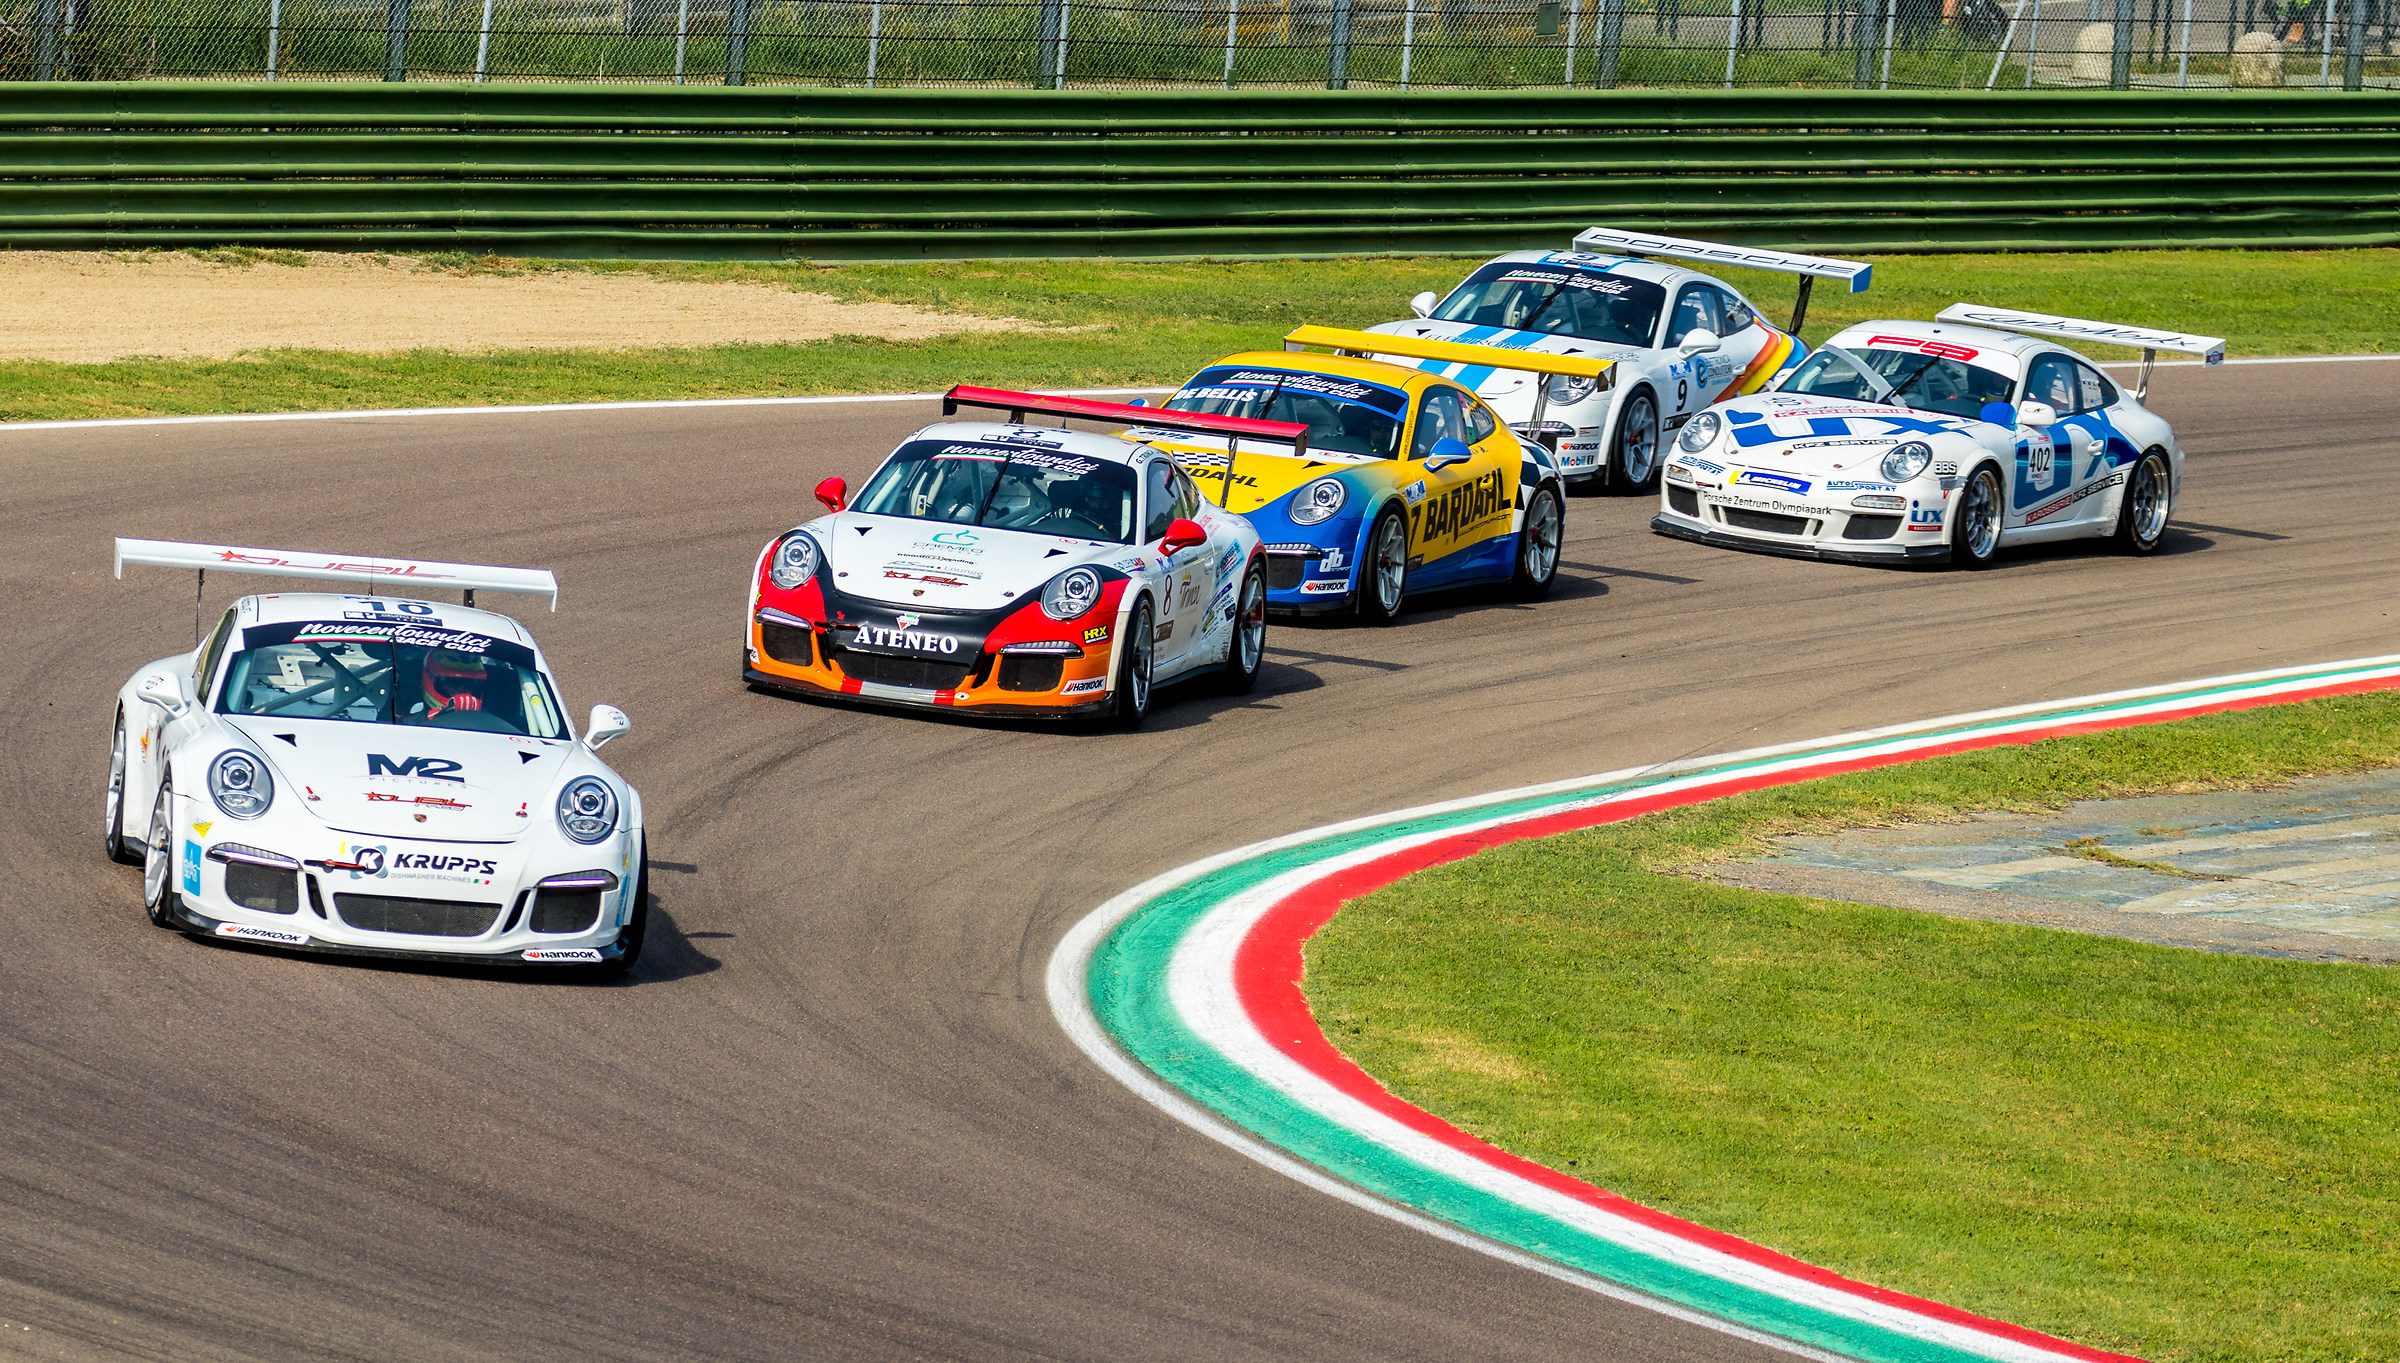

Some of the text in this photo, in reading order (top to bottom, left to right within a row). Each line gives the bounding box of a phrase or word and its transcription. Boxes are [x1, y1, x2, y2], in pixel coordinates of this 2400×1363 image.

[1590, 234, 1857, 274] PORSCHE
[1592, 285, 1622, 296] CUP
[1172, 388, 1259, 402] DE BELLIS
[1230, 371, 1373, 397] Novecntoundici
[1289, 382, 1361, 400] RACE CUP
[1676, 379, 1688, 412] 9
[1794, 438, 1897, 450] KFZ SERVICE
[1009, 457, 1088, 476] RACE CUP
[1561, 455, 1587, 467] Mobil
[1934, 460, 1958, 476] BBS
[2029, 446, 2051, 473] 402
[1750, 475, 1802, 490] MICHELIN
[2073, 474, 2123, 502] KFZ SERVICE
[1408, 467, 1512, 556] 7 BARDAHL
[1703, 491, 1833, 516] Porsche Zentrum Olympiapark
[2026, 496, 2071, 522] KAROSSERIE
[1163, 574, 1173, 616] 8
[390, 636, 486, 653] RACE CUP
[853, 625, 959, 654] ATENEO
[1084, 625, 1107, 640] HRX
[366, 752, 466, 784] M2
[393, 852, 498, 876] KRUPPS
